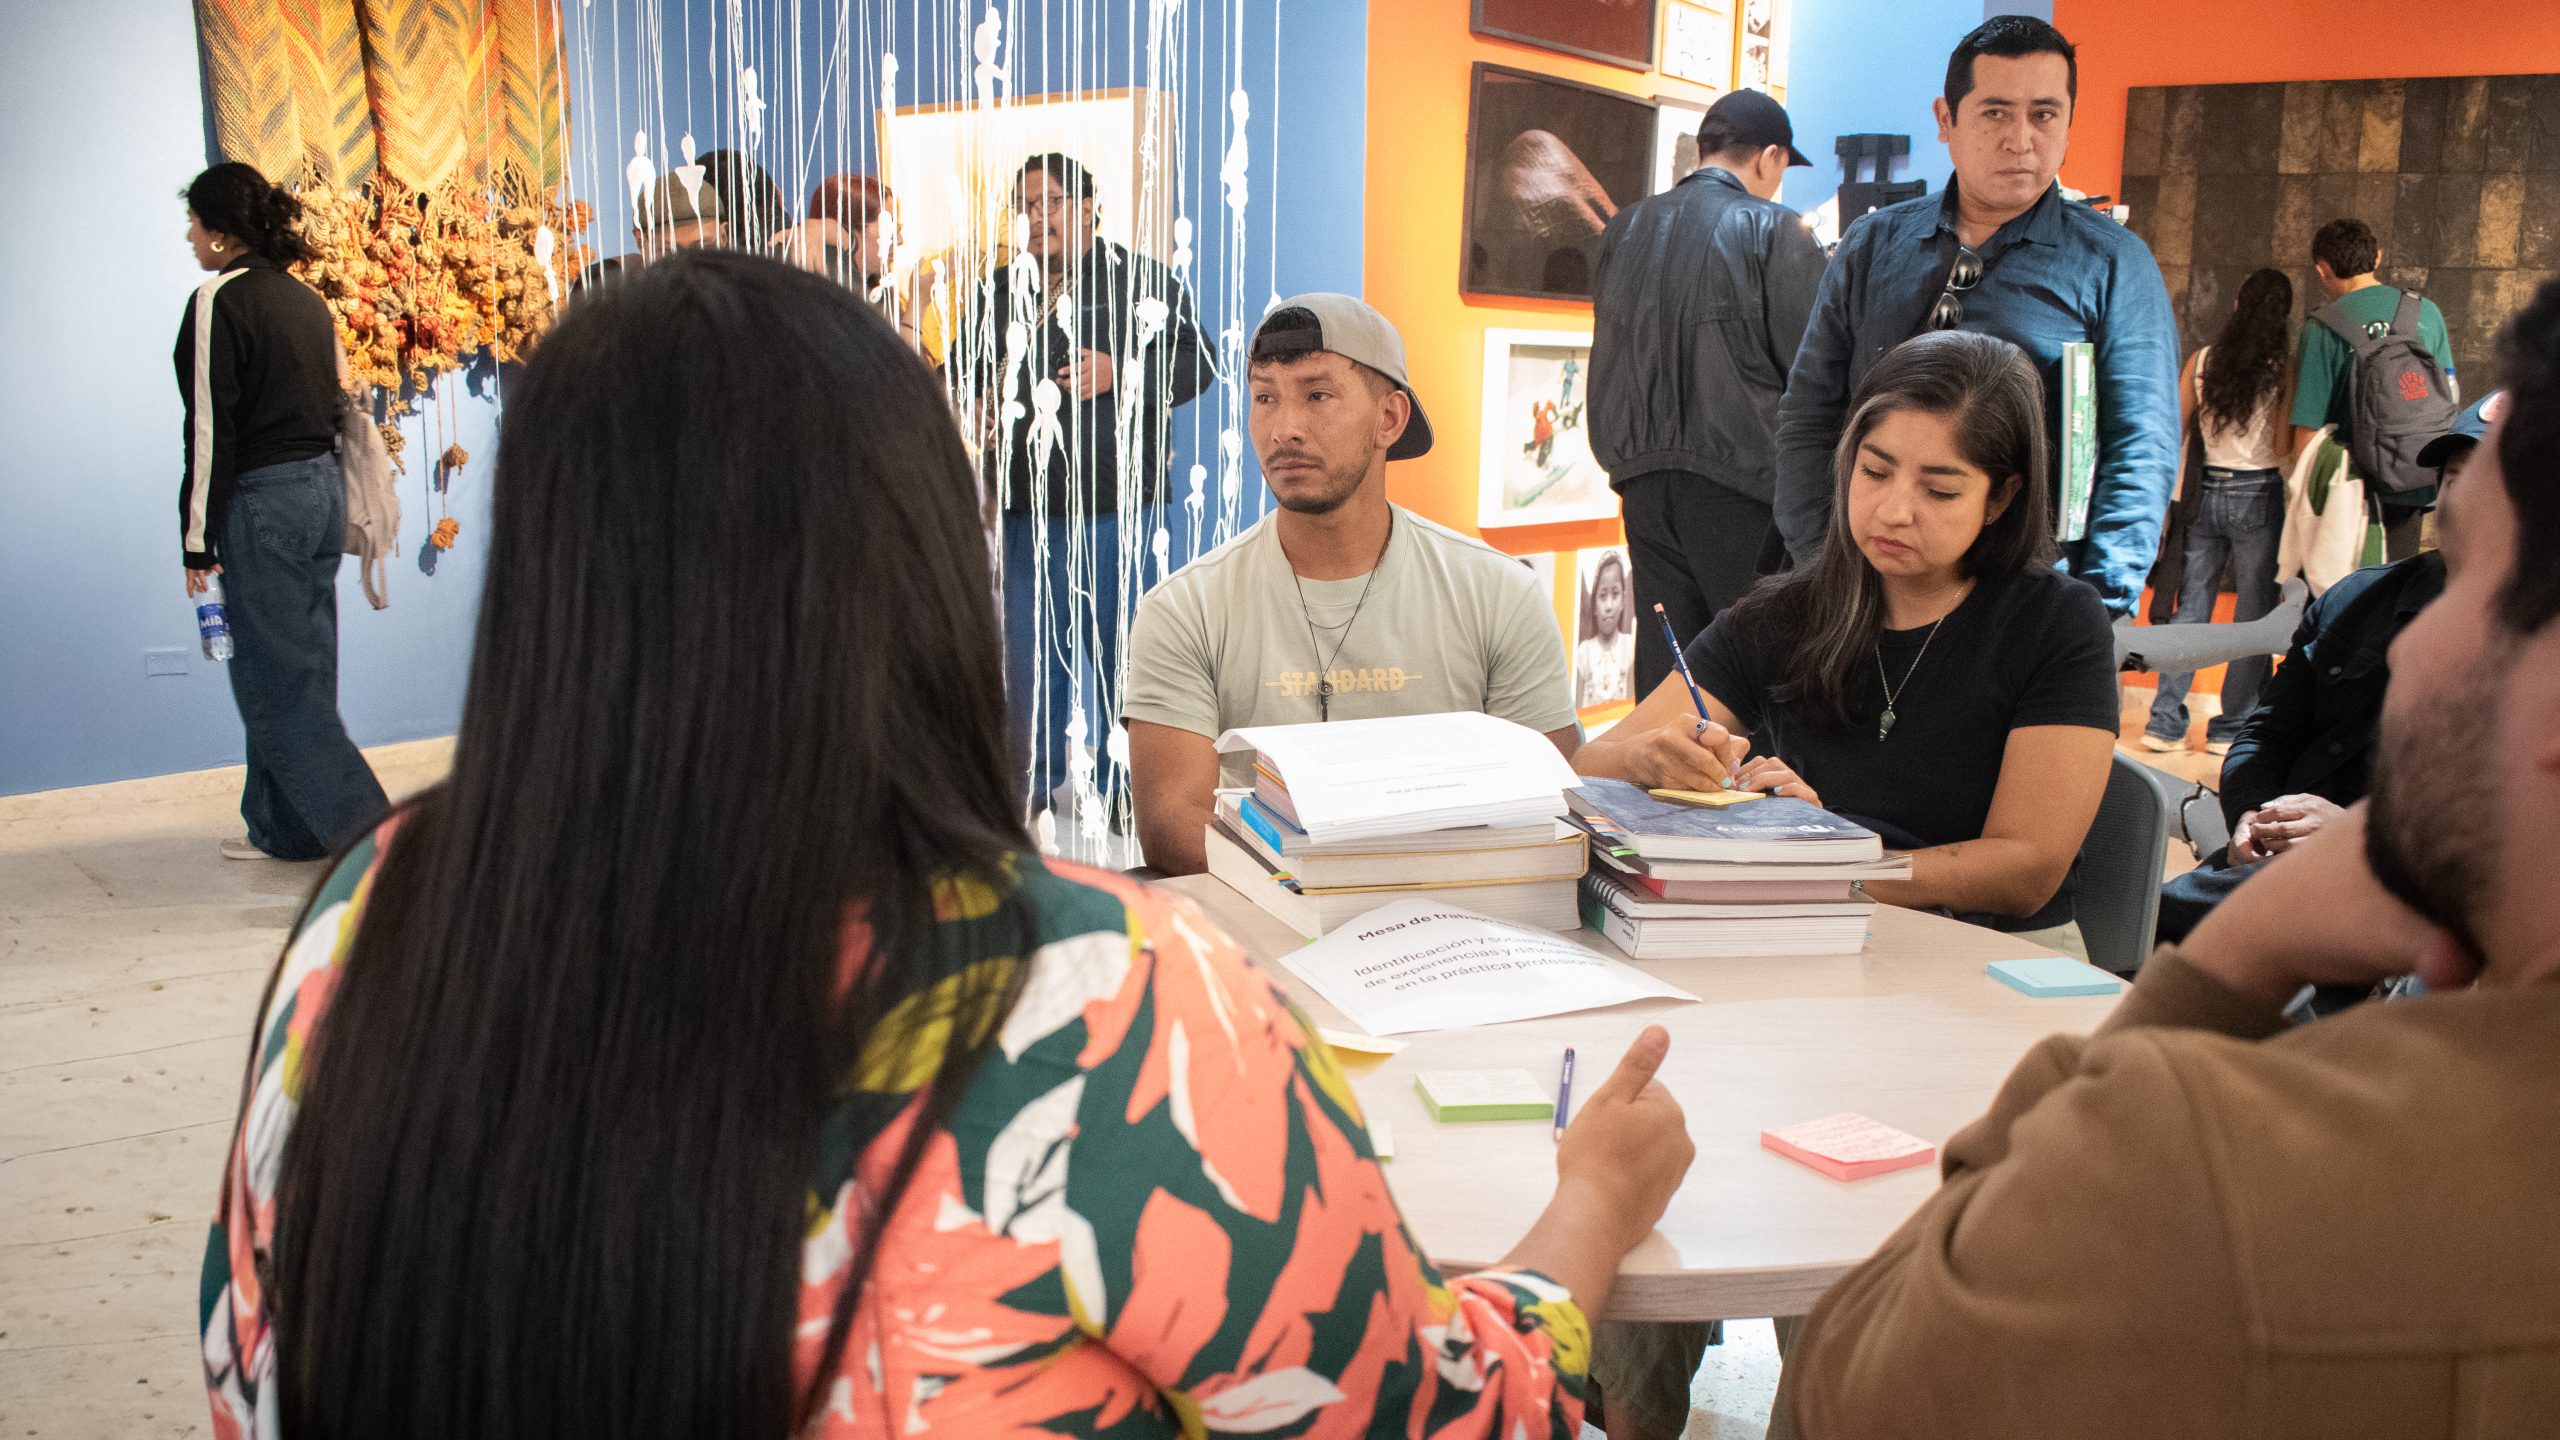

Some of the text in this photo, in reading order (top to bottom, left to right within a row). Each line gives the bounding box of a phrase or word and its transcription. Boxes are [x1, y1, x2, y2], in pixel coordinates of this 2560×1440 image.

[1278, 668, 1405, 697] STANDARD
[1358, 922, 1406, 941] Mesa
[1410, 916, 1431, 925] de
[1354, 938, 1473, 977] Identificación
[1474, 937, 1484, 945] y
[1364, 979, 1387, 989] de
[1390, 949, 1500, 980] experiencias
[1501, 948, 1511, 956] y
[1395, 981, 1418, 991] en
[1419, 974, 1438, 983] la
[1441, 963, 1512, 980] práctica
